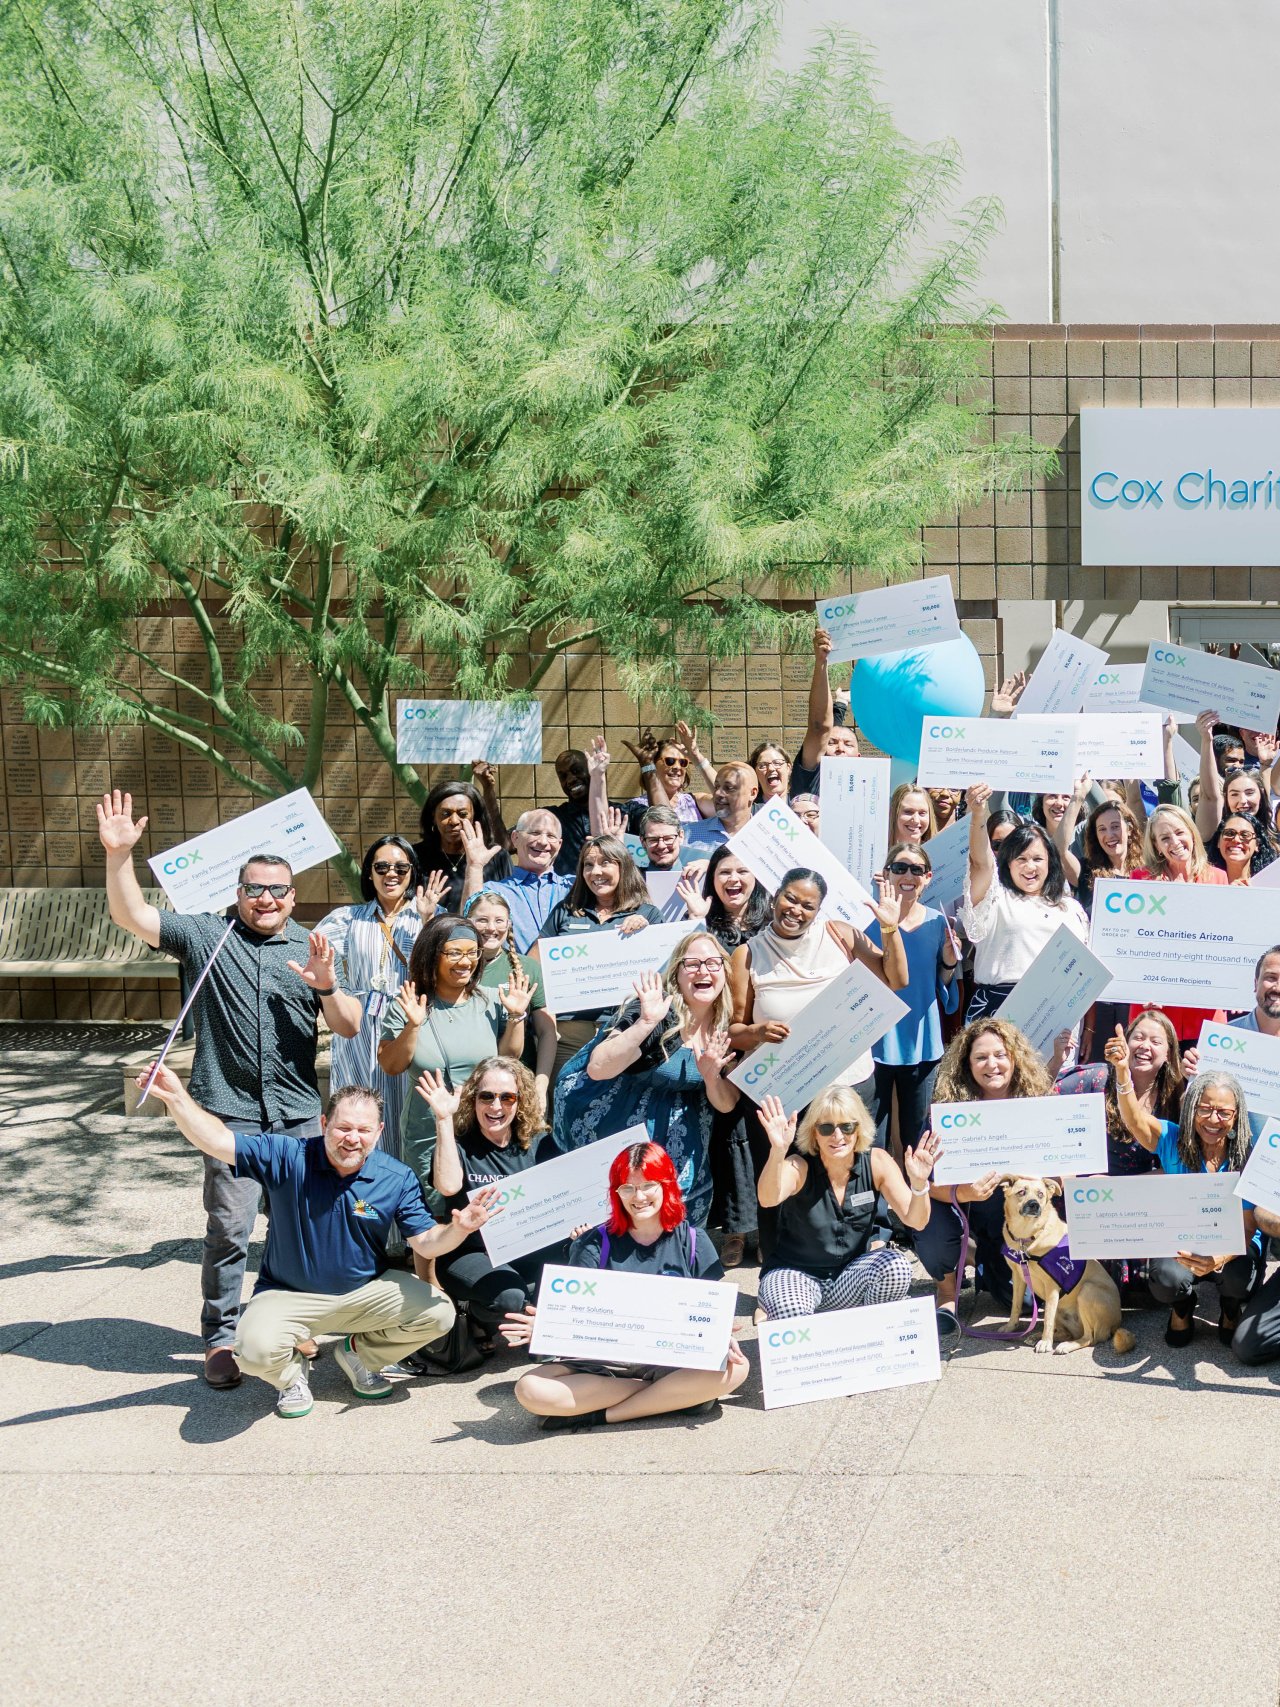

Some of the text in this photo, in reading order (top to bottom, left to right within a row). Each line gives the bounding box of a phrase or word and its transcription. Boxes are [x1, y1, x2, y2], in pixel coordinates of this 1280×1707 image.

[1091, 471, 1163, 504] Cox
[824, 603, 856, 619] COX
[1154, 649, 1186, 667] COX
[929, 726, 965, 738] COX
[284, 821, 305, 834] $5,000
[768, 809, 799, 842] COX
[163, 848, 204, 875] COX
[190, 868, 208, 880] Family
[250, 838, 271, 852] Phoenix
[1104, 892, 1167, 916] COX
[1138, 928, 1233, 942] Cox Charities Arizona
[548, 943, 589, 960] COX
[1116, 947, 1256, 964] Six hundred ninty-eight thousand five
[571, 956, 658, 972] Butterfly Wonderland Foundation
[1179, 977, 1211, 986] Recipients
[849, 992, 869, 1011] $10,000
[1207, 1033, 1247, 1053] COX
[770, 1029, 823, 1078] Arizona Technology Council
[744, 1050, 781, 1084] COX
[940, 1112, 981, 1128] COX
[988, 1133, 1007, 1141] Angels
[509, 1189, 570, 1217] Read Better Be Better
[1073, 1188, 1114, 1203] COX
[550, 1277, 597, 1296] COX
[584, 1305, 614, 1314] Solutions
[584, 1319, 613, 1327] Thousand
[688, 1314, 711, 1323] $5,000
[768, 1327, 811, 1347] COX
[898, 1333, 917, 1342] $7,500
